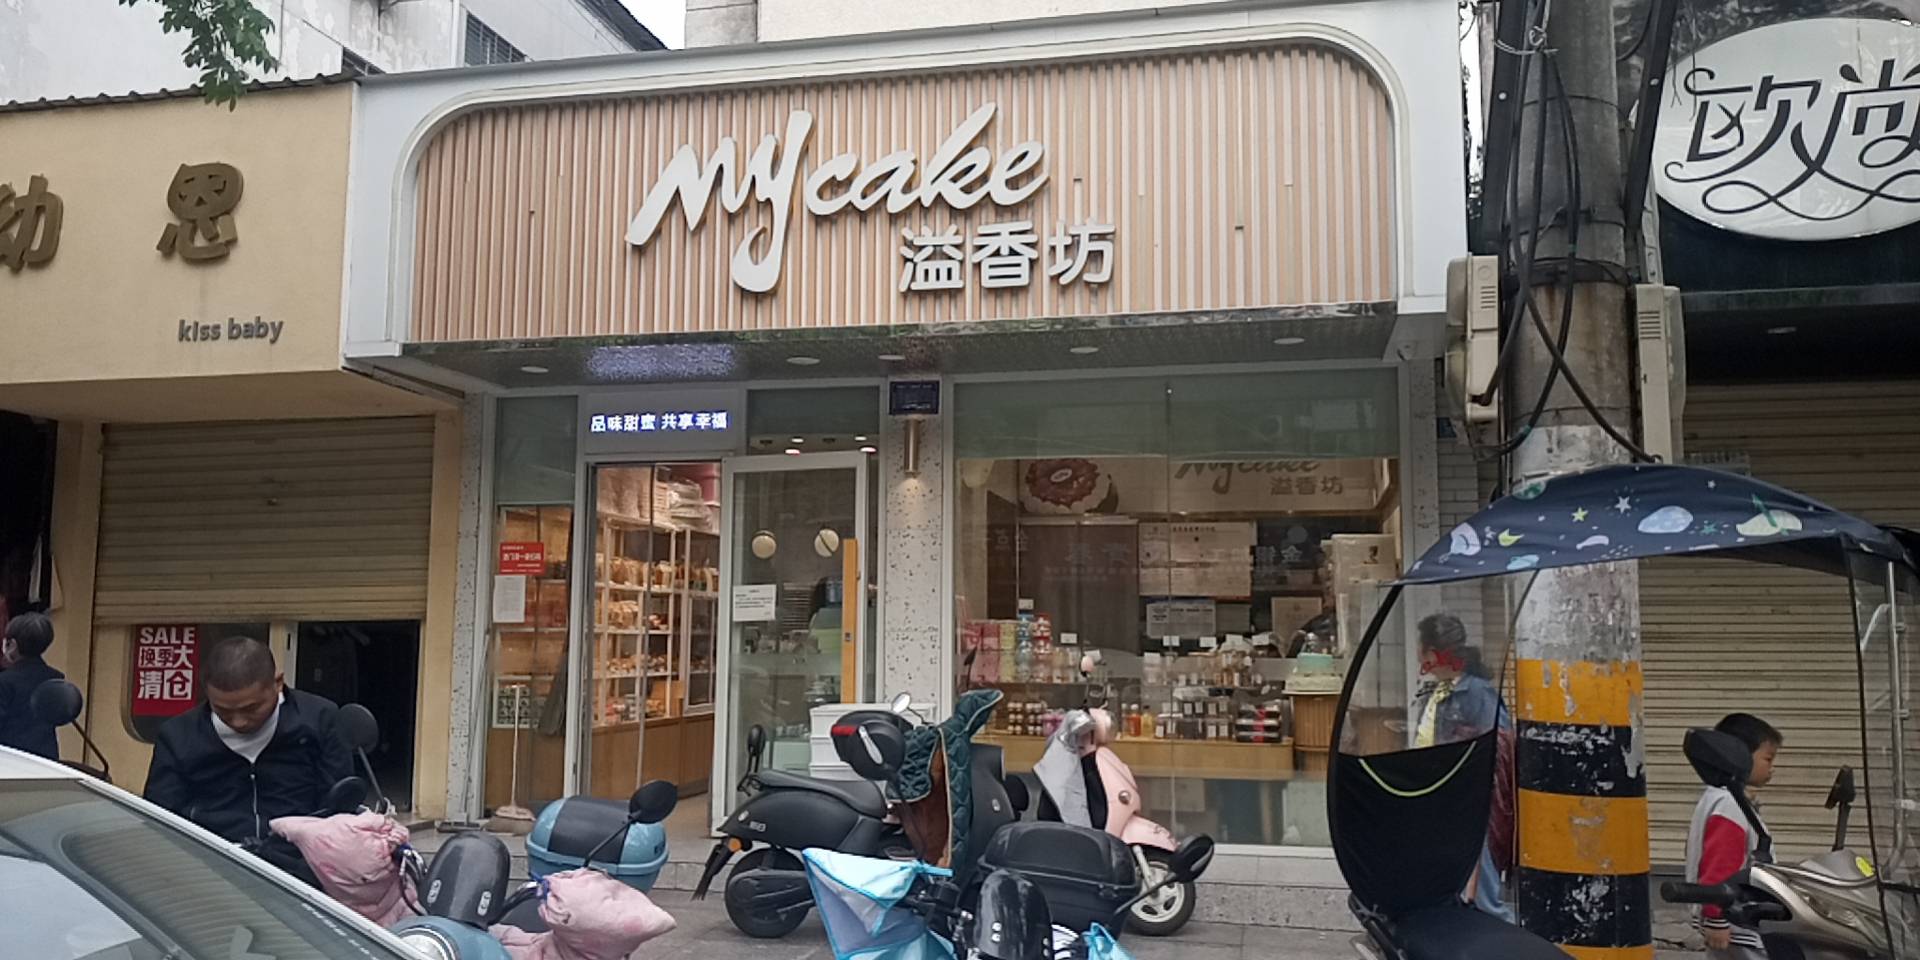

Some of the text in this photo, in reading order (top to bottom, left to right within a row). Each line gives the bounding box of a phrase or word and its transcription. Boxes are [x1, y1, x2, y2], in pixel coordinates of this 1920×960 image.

[898, 218, 1116, 293] 溢香坊
[178, 316, 284, 344] kiss baby
[591, 411, 728, 433] 品味甜蜜 共享幸福
[1270, 475, 1344, 496] 溢香坊
[140, 626, 195, 645] SALE
[137, 669, 193, 701] 清仓
